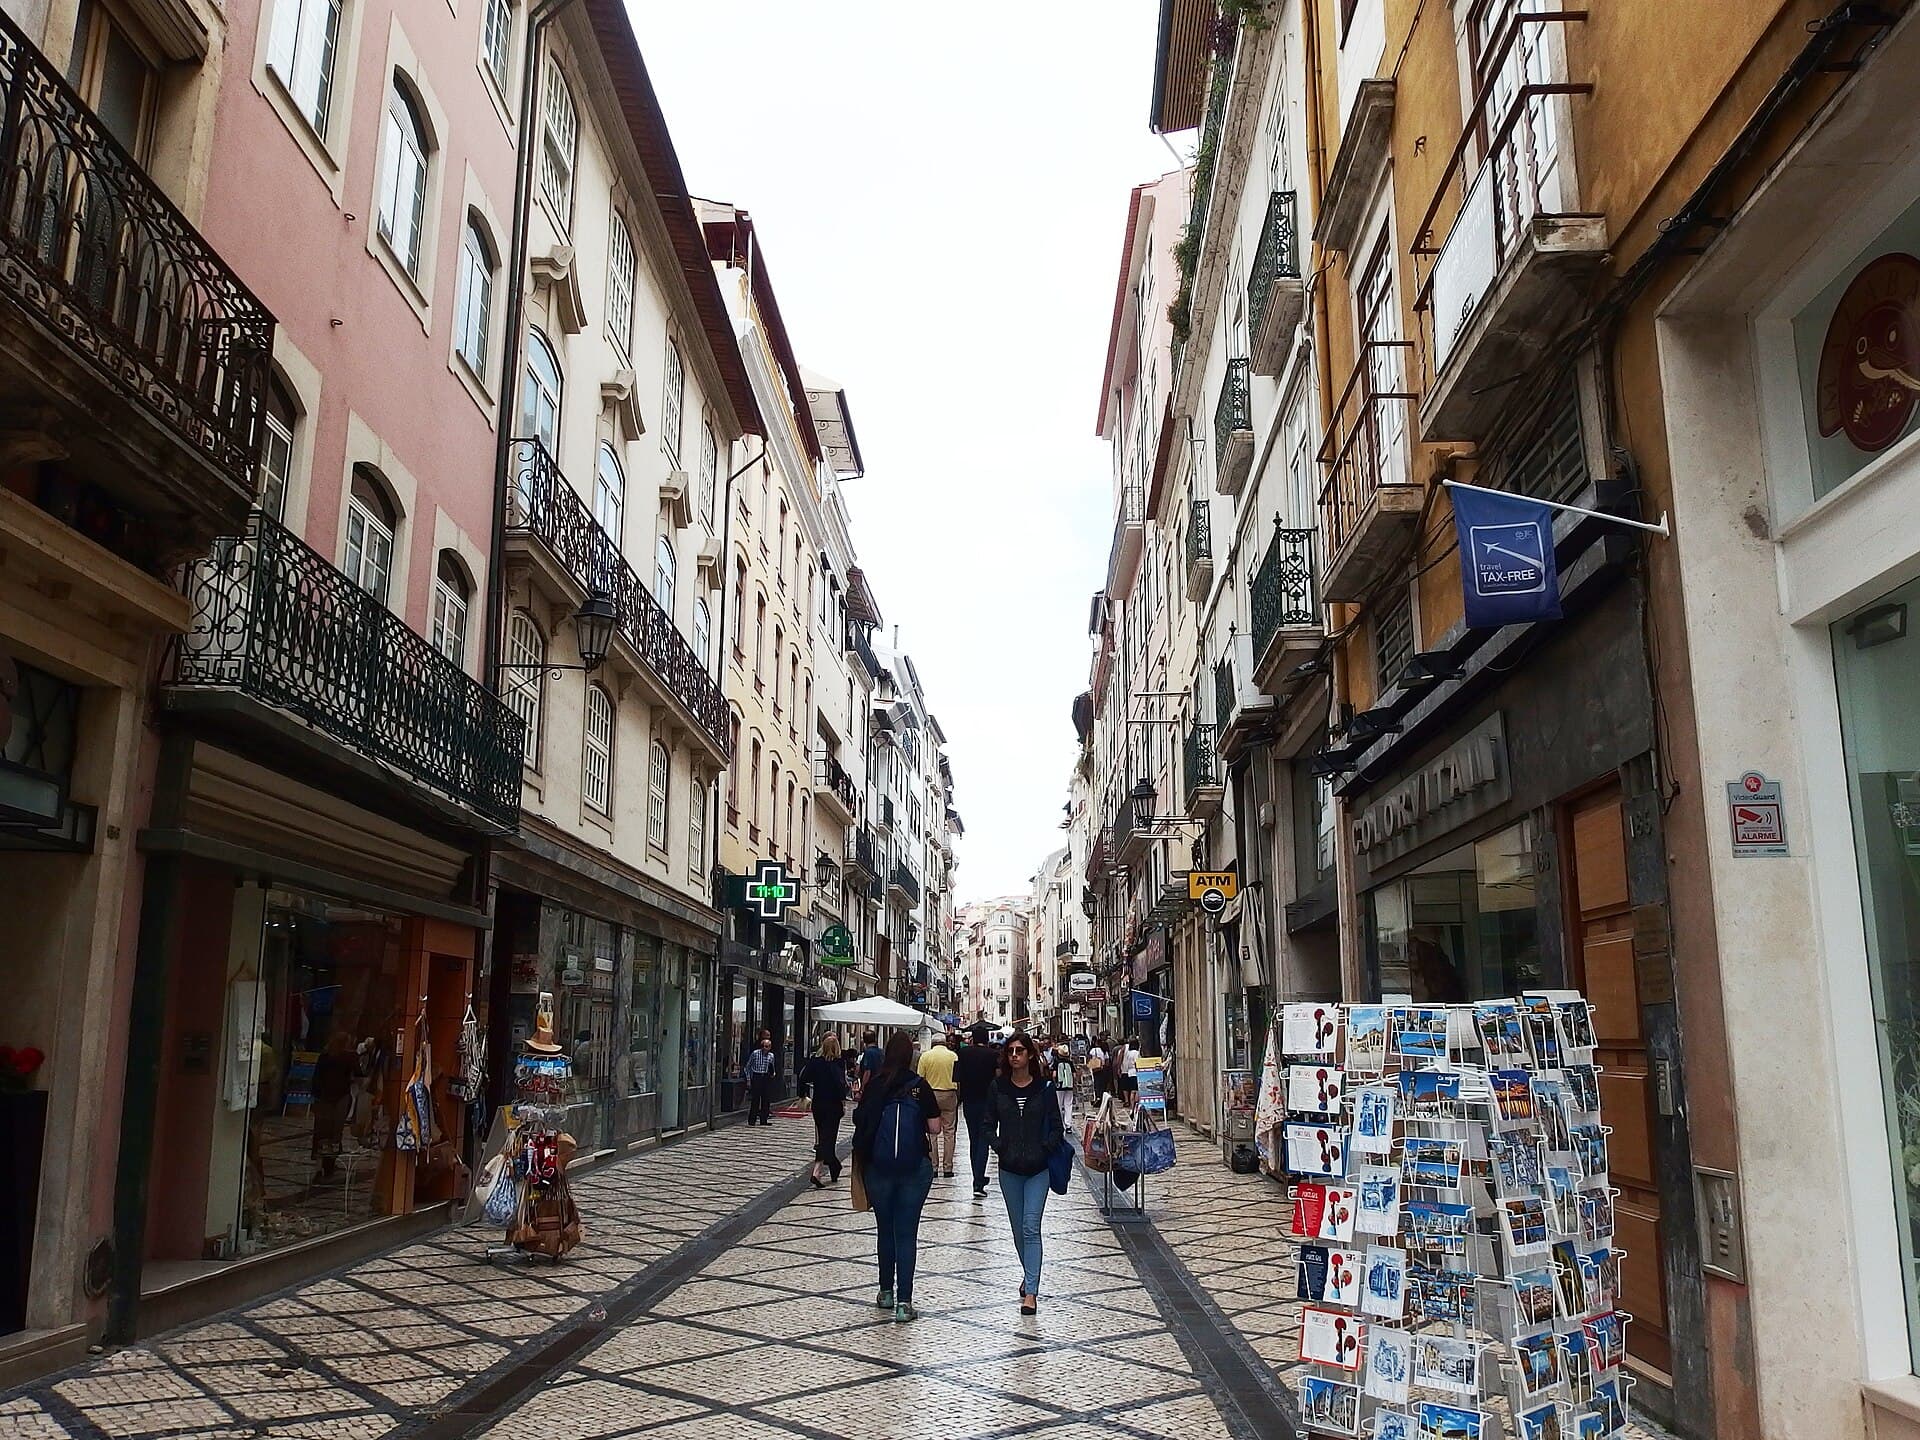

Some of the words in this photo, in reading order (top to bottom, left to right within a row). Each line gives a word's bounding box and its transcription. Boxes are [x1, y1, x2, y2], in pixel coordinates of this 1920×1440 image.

[1480, 563, 1501, 571] travel
[1480, 569, 1536, 583] TAX-FREE
[1741, 832, 1777, 840] ALARME
[1195, 875, 1231, 887] ATM
[756, 885, 785, 898] 11:10
